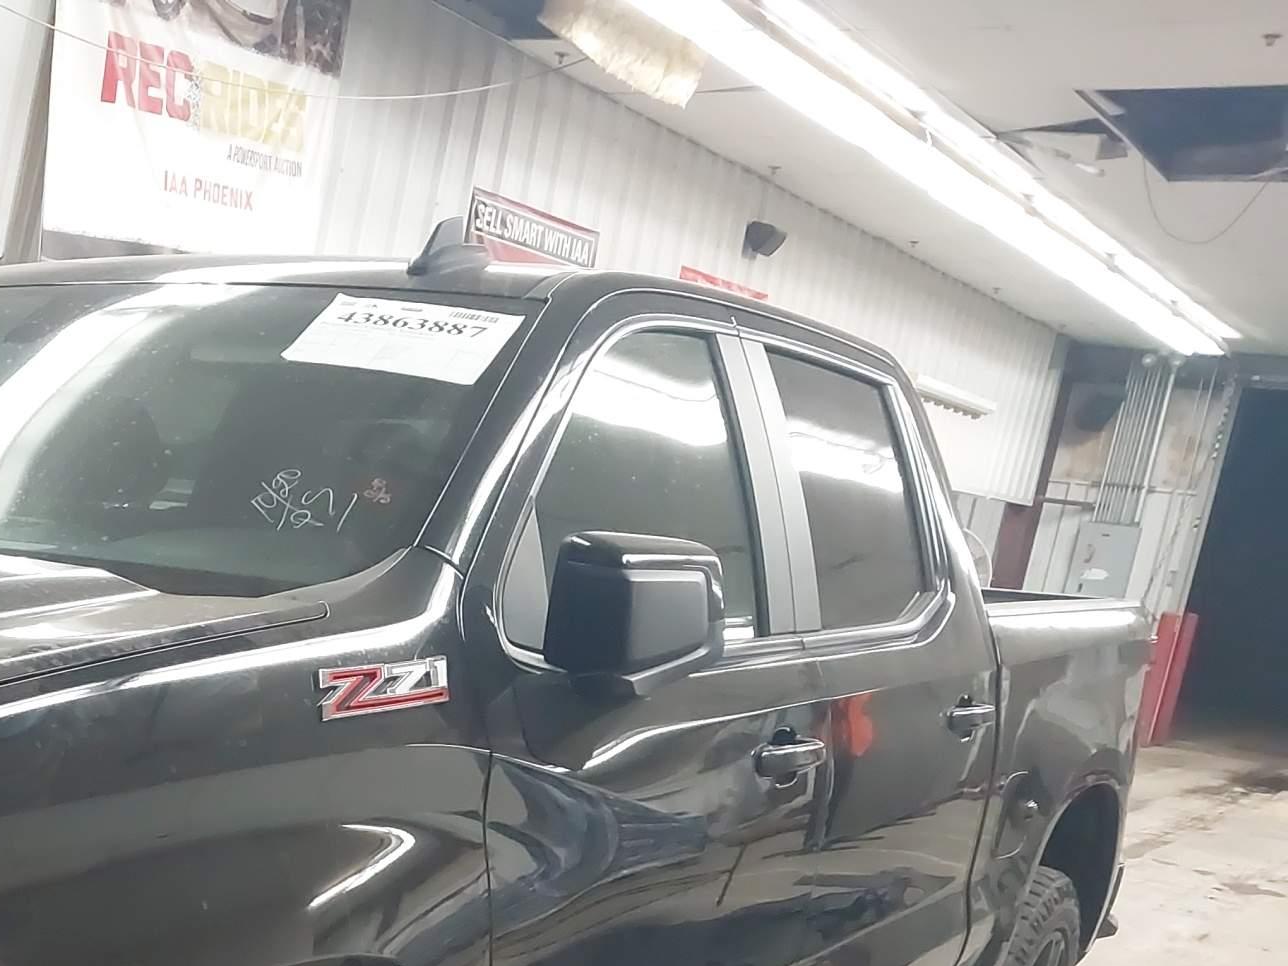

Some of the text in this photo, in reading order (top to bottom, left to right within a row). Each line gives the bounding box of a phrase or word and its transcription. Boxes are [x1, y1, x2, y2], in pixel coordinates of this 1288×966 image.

[100, 31, 193, 122] REC
[226, 143, 233, 161] A
[273, 156, 303, 177] AUCTION
[163, 169, 254, 211] IAA PHOENIX
[475, 203, 590, 266] SELL SMART WITH IAA
[337, 310, 489, 338] 43863887
[318, 654, 450, 722] Z71
